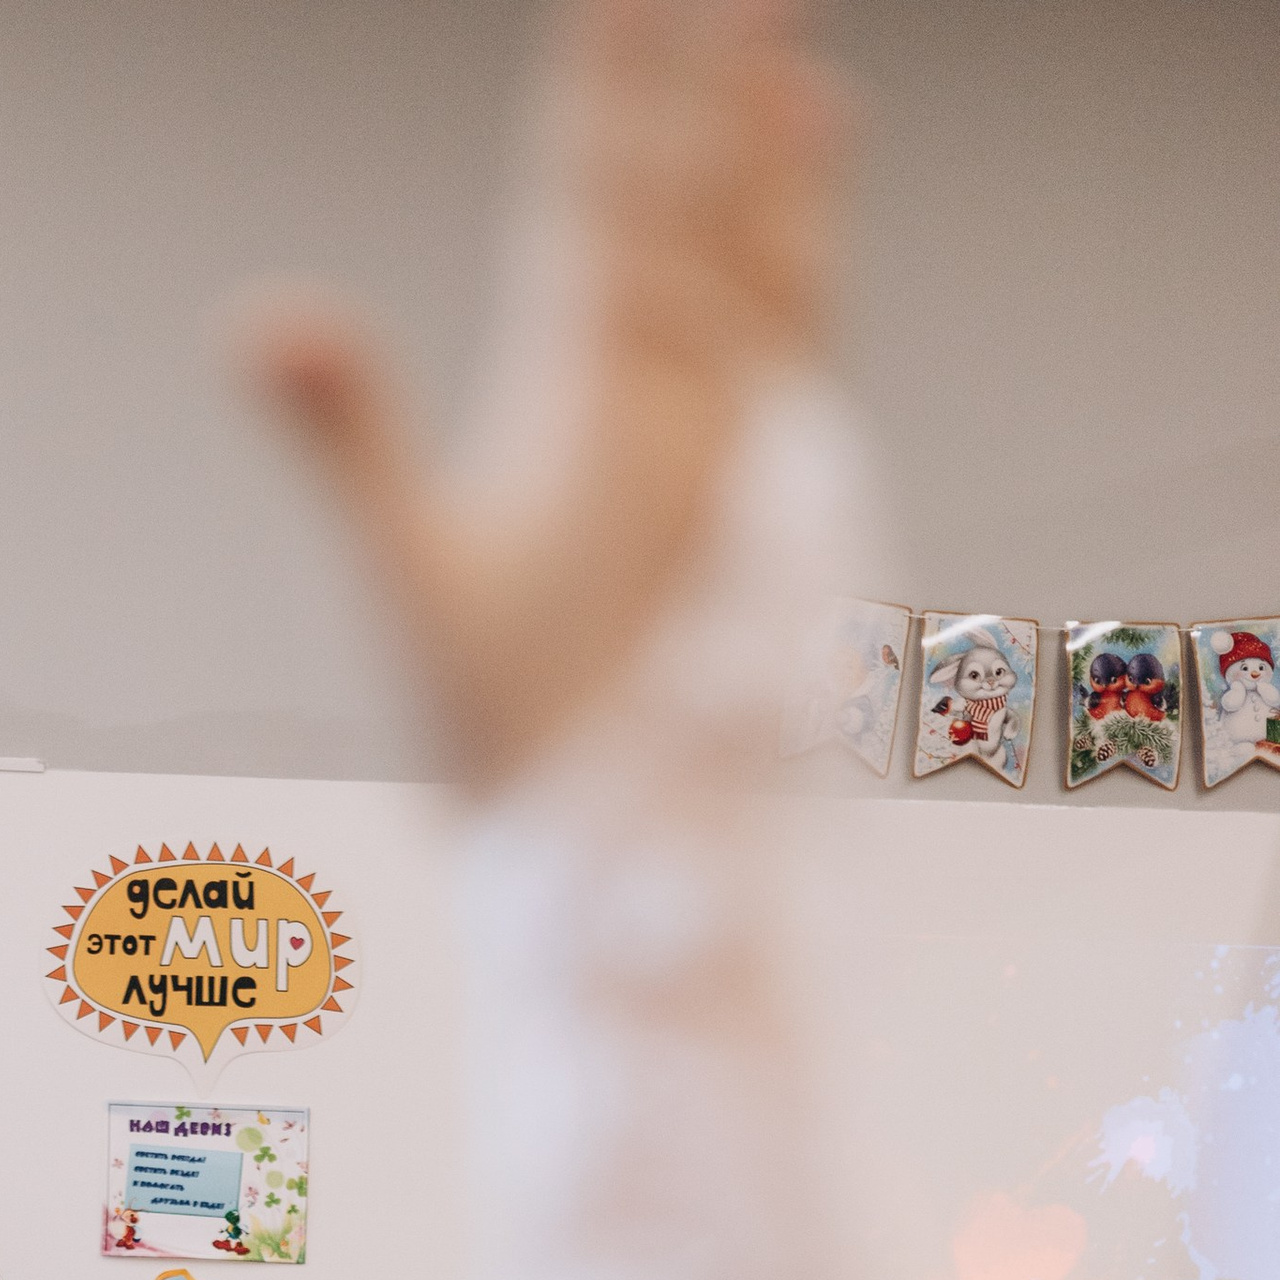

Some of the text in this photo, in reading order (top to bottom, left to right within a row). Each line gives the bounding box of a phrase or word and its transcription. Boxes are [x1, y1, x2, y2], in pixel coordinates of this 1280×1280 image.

[126, 871, 255, 919] делай
[86, 933, 157, 956] этот
[121, 973, 257, 1018] лучше
[129, 1119, 170, 1135] НАШ
